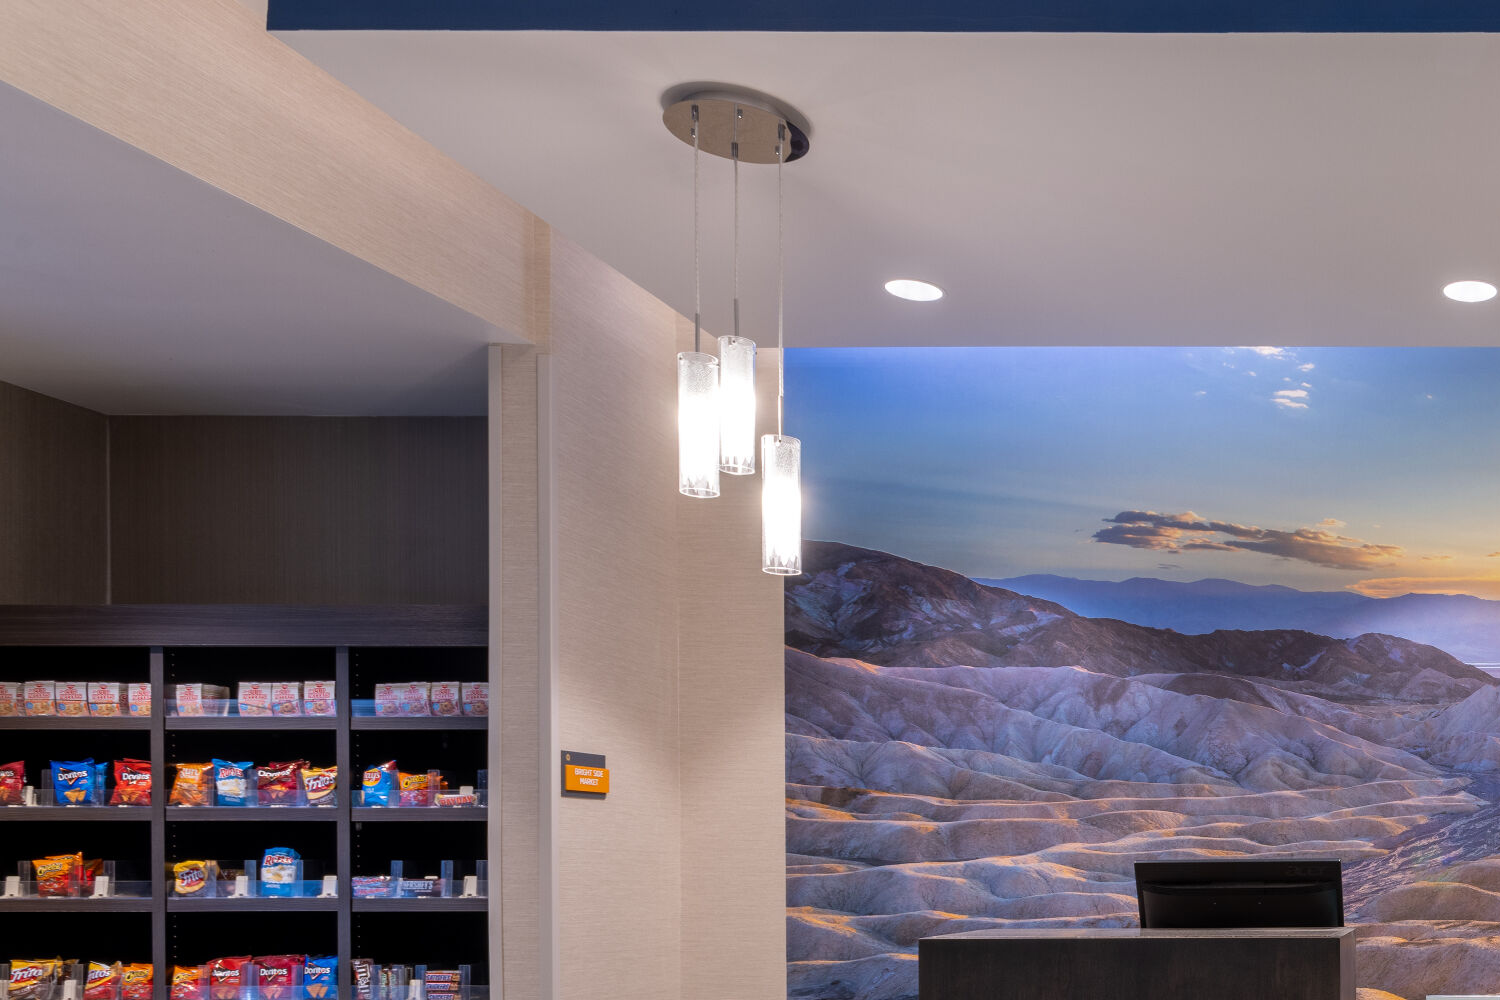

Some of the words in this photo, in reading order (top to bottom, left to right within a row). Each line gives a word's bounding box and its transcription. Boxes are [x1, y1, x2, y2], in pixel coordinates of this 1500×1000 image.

[57, 770, 88, 781] Doritos
[121, 772, 151, 780] Doritos
[575, 768, 592, 776] BRIGHT
[593, 770, 604, 778] SIDE
[580, 778, 598, 786] MARKET
[260, 968, 287, 976] Doritos
[304, 966, 331, 975] Doritos
